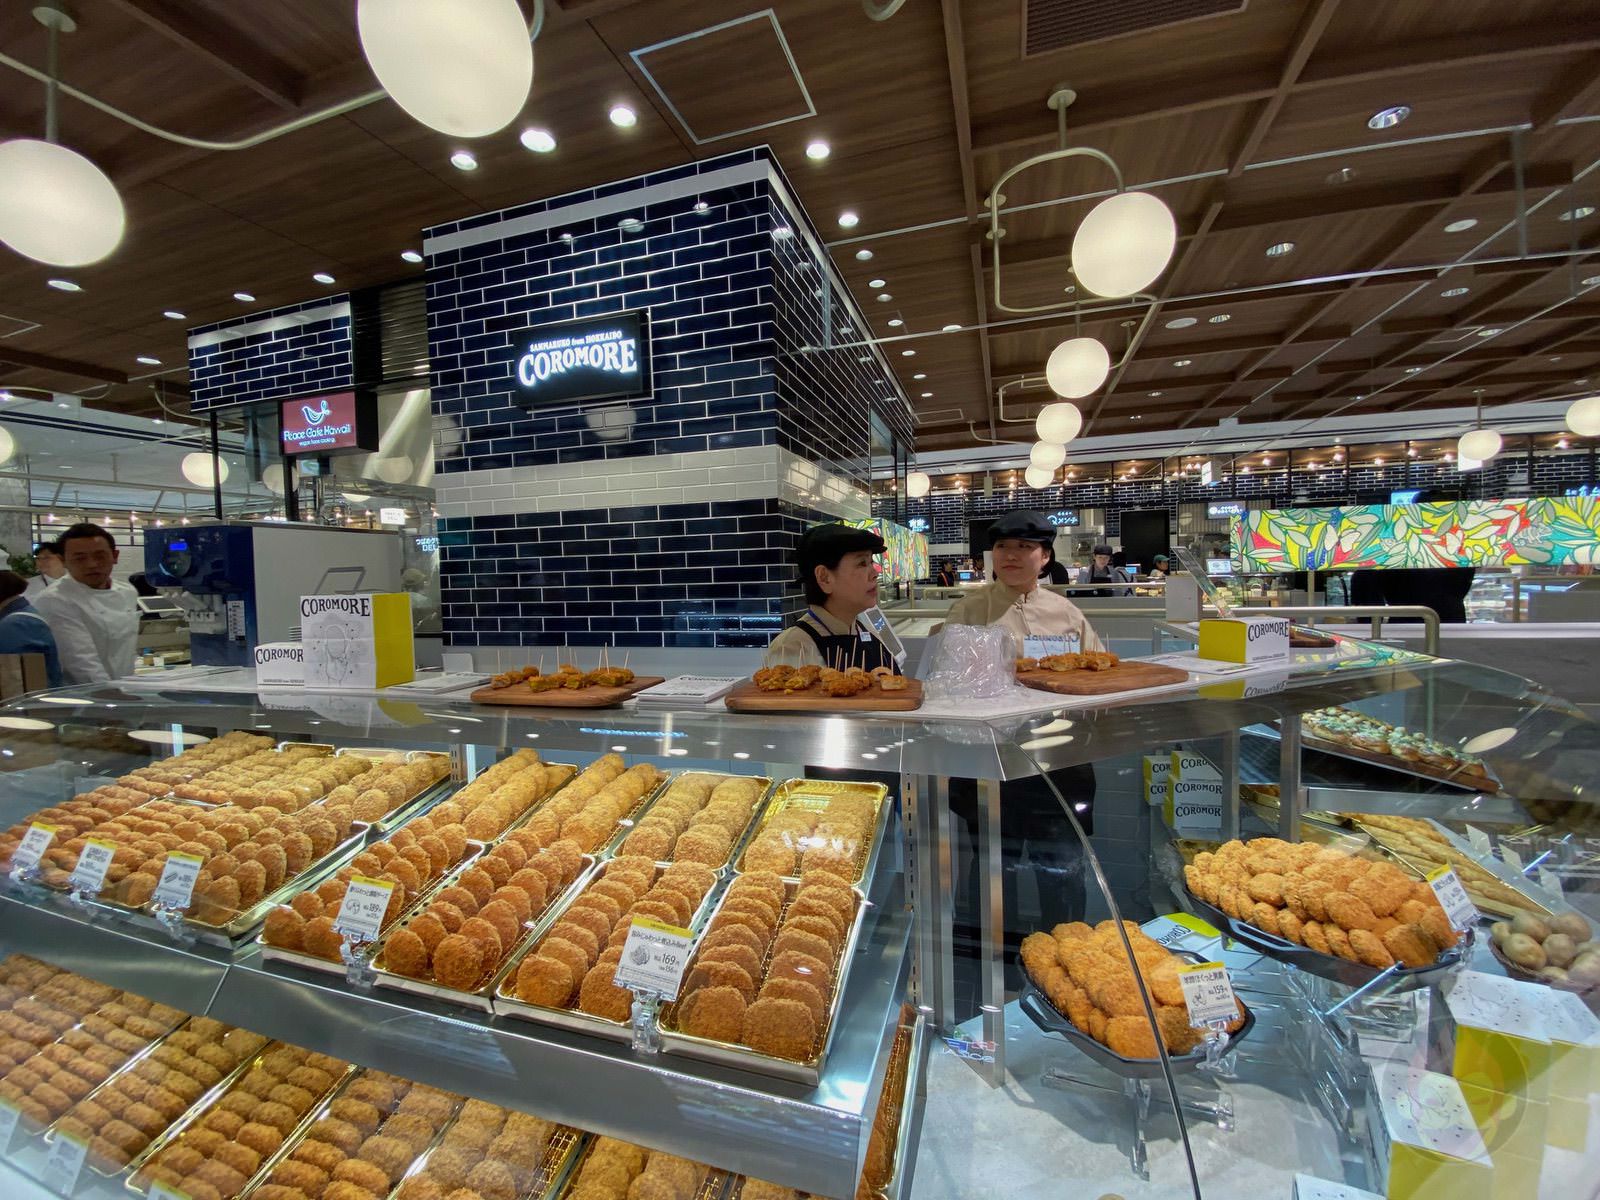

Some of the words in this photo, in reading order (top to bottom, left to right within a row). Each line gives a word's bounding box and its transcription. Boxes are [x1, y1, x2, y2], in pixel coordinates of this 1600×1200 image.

[518, 339, 637, 387] COROMORE
[306, 427, 323, 437] Cafe
[301, 598, 370, 618] COROMORE
[1247, 621, 1289, 642] COROMORE
[255, 648, 304, 665] COROMOR
[1174, 782, 1223, 794] COROMOR
[1175, 806, 1222, 817] COROMOR
